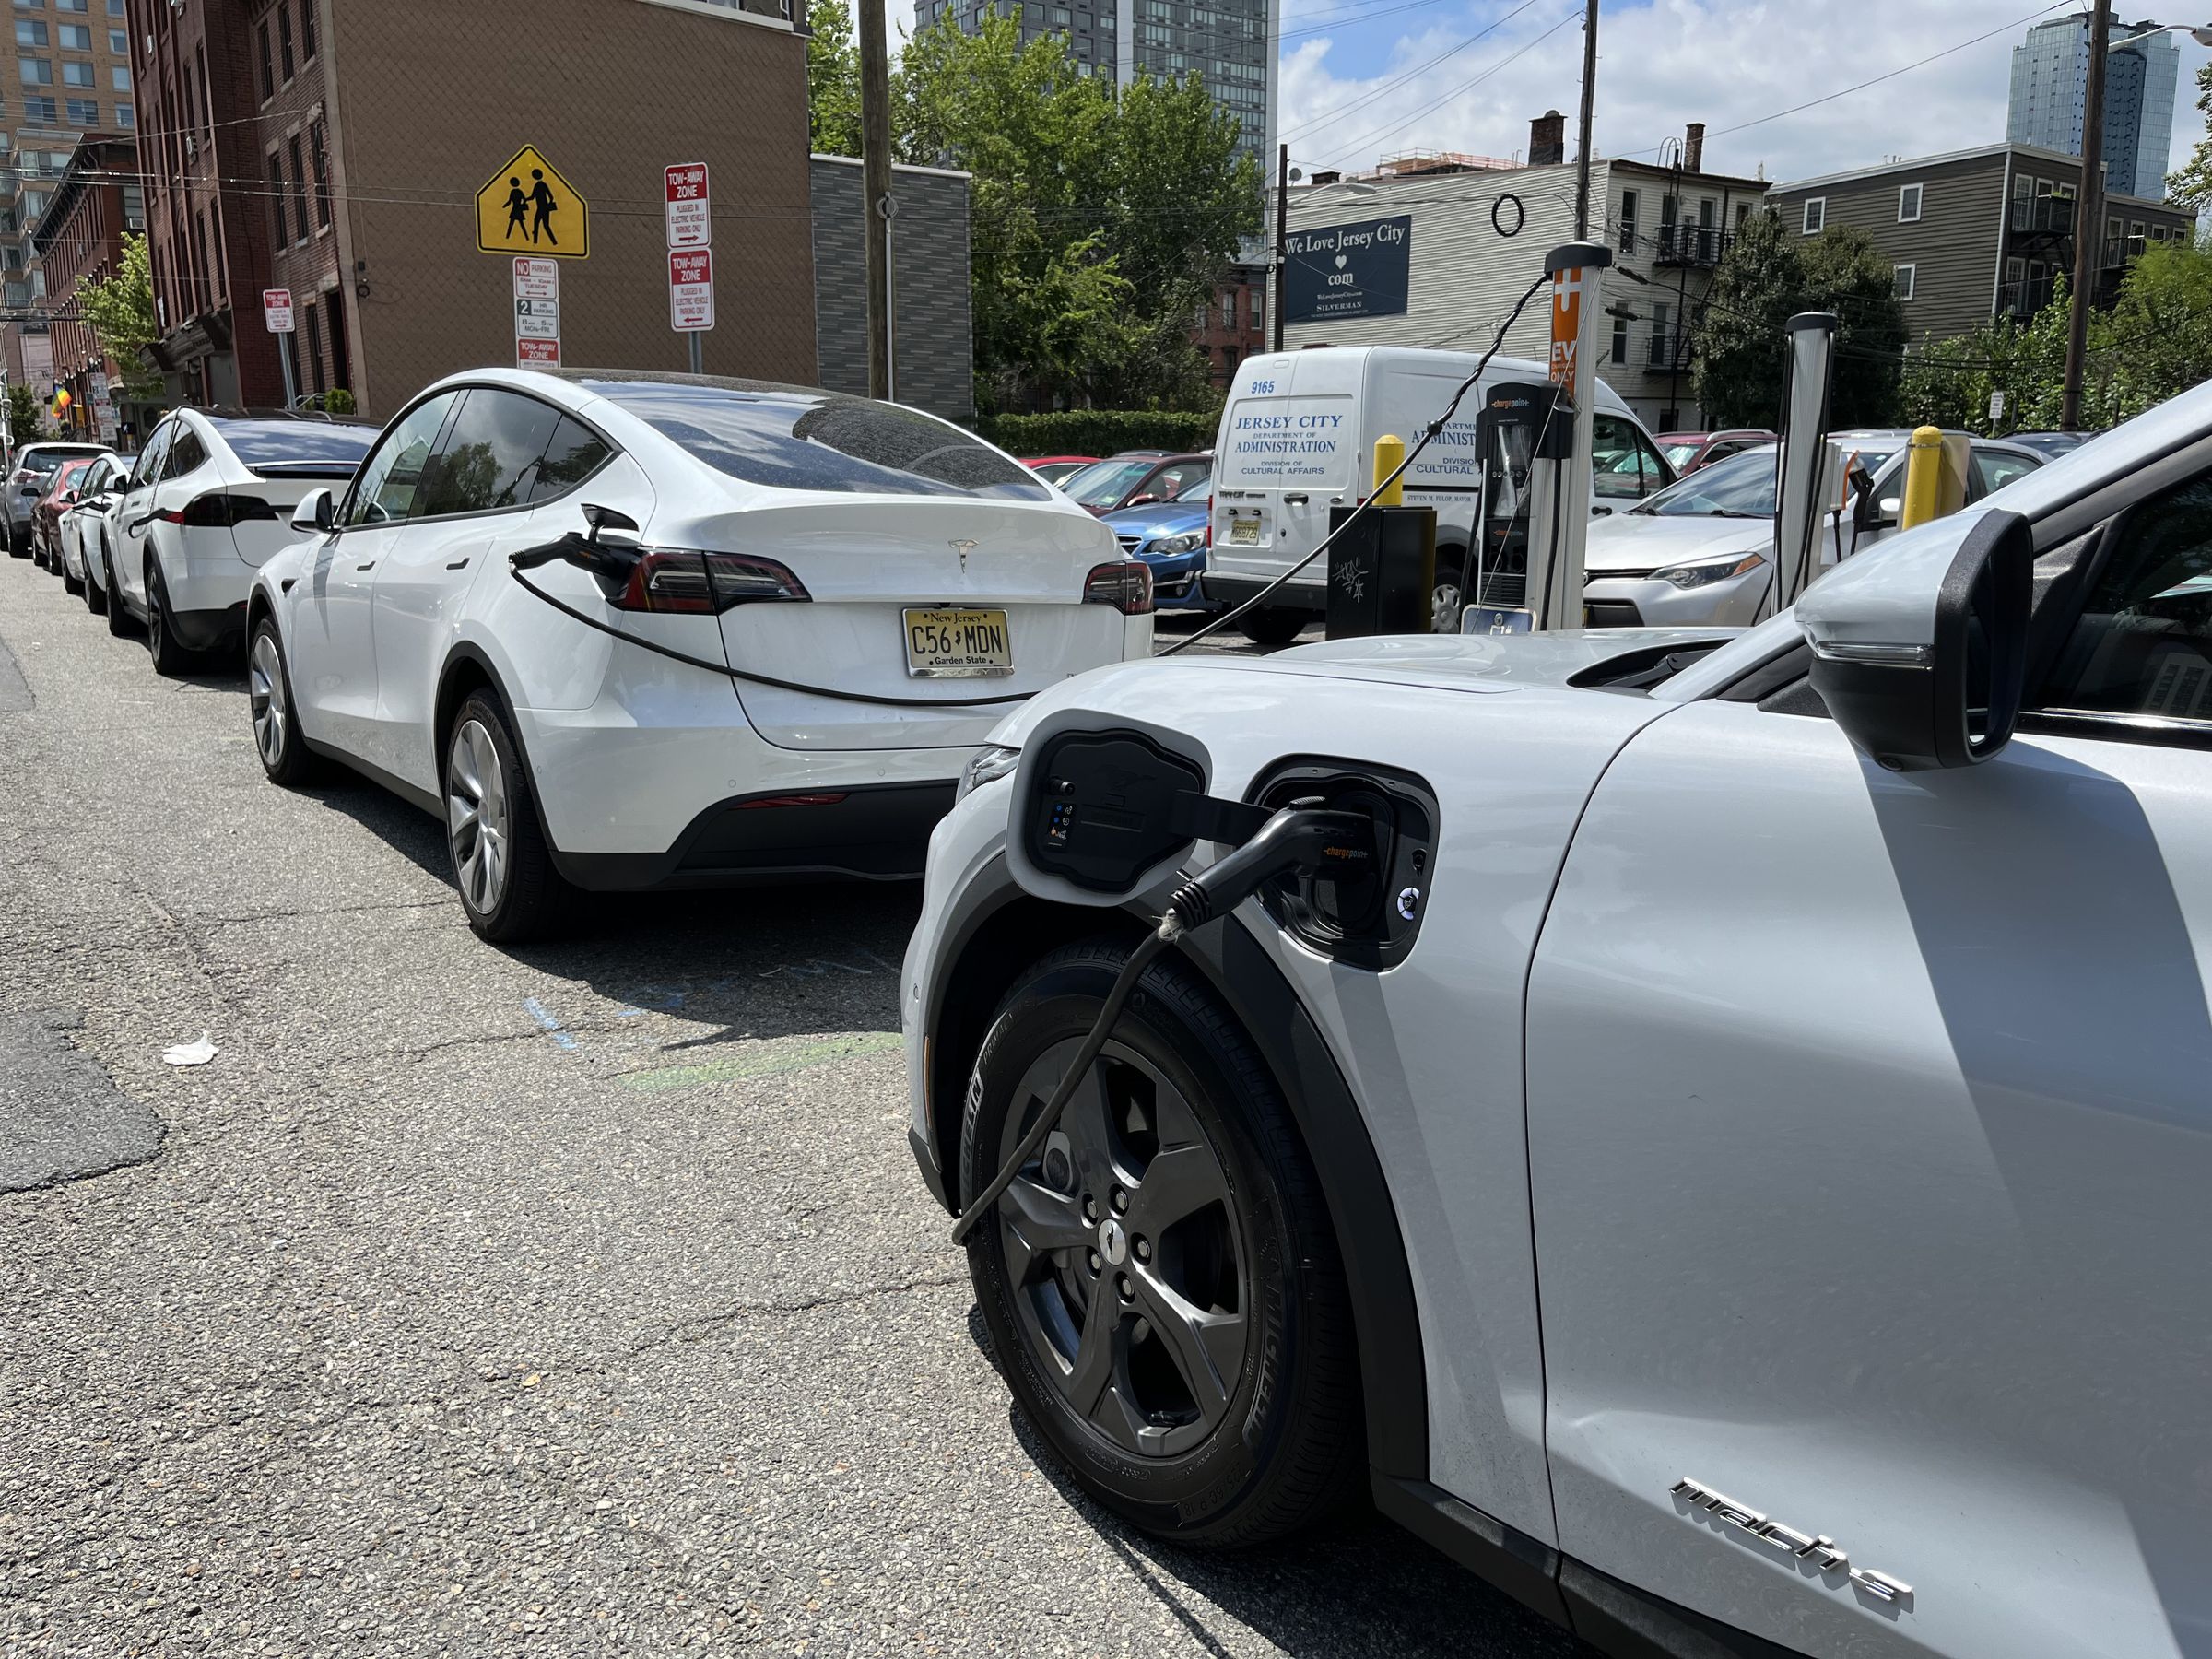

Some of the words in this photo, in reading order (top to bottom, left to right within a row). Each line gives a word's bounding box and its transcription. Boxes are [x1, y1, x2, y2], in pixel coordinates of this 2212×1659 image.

[668, 171, 704, 185] TOW-AWAY
[677, 185, 697, 198] ZONE
[1285, 237, 1302, 254] We
[1306, 235, 1335, 253] Love
[1335, 230, 1374, 252] Jersey
[1376, 224, 1406, 245] City
[517, 262, 529, 275] NO
[531, 264, 552, 273] PARKING
[672, 256, 707, 270] TOW-AWAY
[681, 269, 700, 282] ZONE
[1328, 272, 1354, 286] com
[520, 300, 529, 314] 2
[1316, 301, 1363, 312] SILVERMAN
[520, 342, 557, 351] TOW-AWAY
[1552, 340, 1576, 361] EV
[528, 350, 549, 359] ZONE
[1550, 371, 1575, 382] ONLY
[1251, 381, 1275, 394] 9165
[1235, 417, 1292, 429] JERSEY
[1299, 415, 1343, 428] CITY
[1235, 441, 1336, 453] ADMINISTRATION
[1442, 457, 1477, 465] DIVISIO
[1416, 465, 1474, 475] CULTURAL
[930, 613, 952, 622] New
[954, 613, 982, 624] Jersey
[912, 626, 952, 654] C56
[964, 625, 1003, 653] MDN
[935, 656, 963, 665] Garden
[966, 655, 986, 664] State
